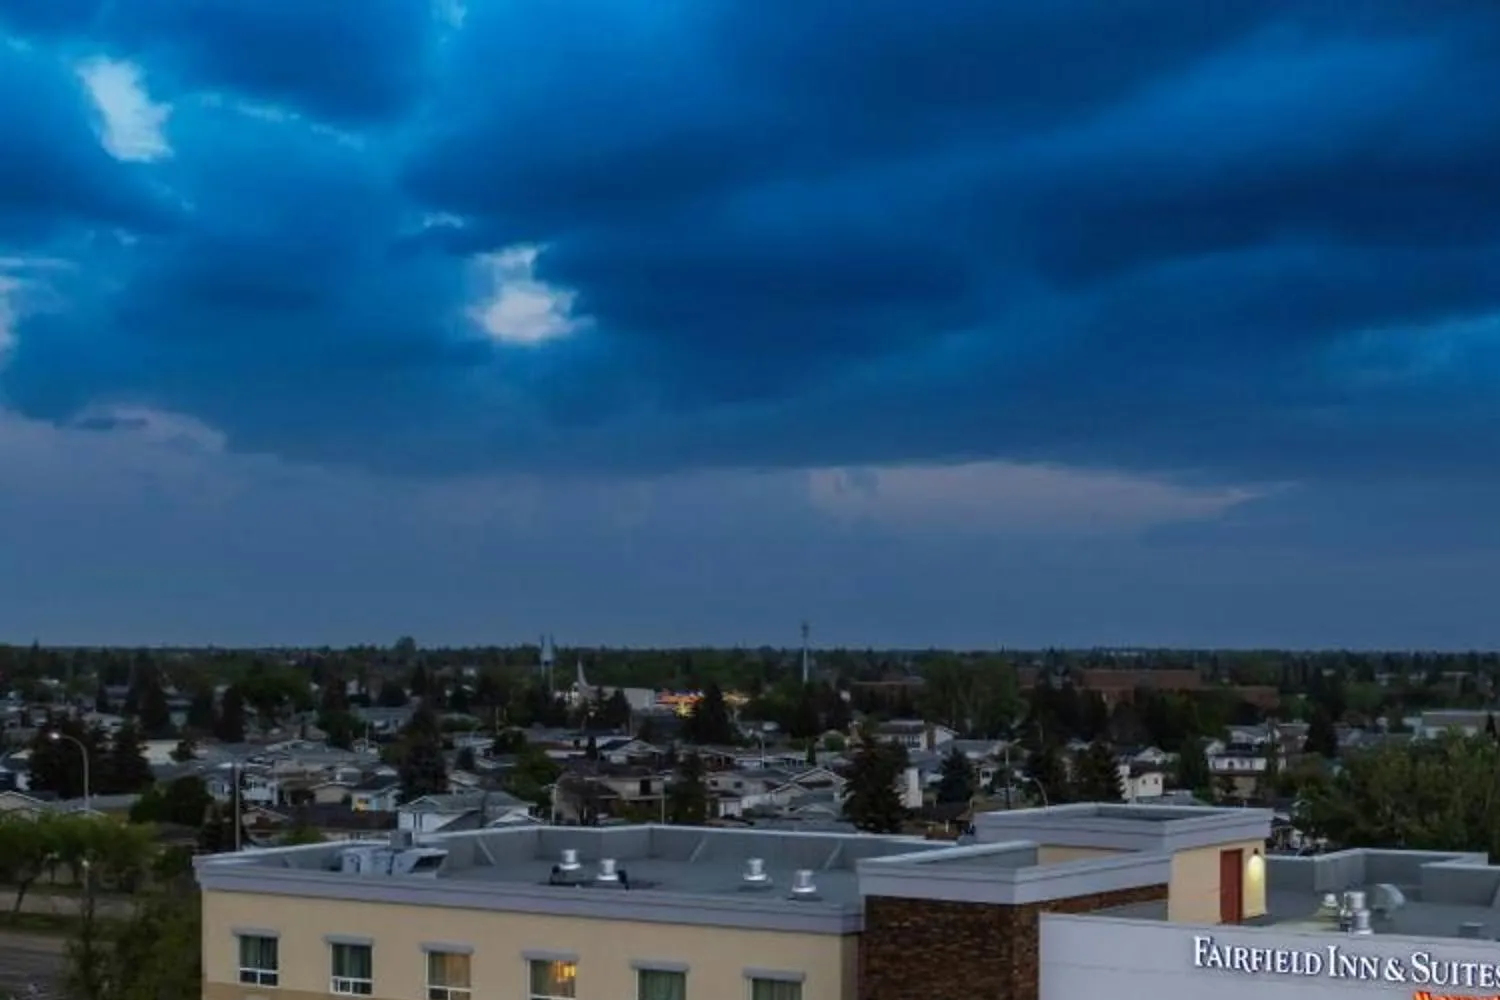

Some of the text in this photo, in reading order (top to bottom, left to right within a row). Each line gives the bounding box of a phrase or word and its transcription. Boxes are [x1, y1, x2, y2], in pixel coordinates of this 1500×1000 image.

[1193, 935, 1321, 974] FAIRFIELD
[1327, 945, 1378, 979] INN
[1384, 959, 1405, 982] &
